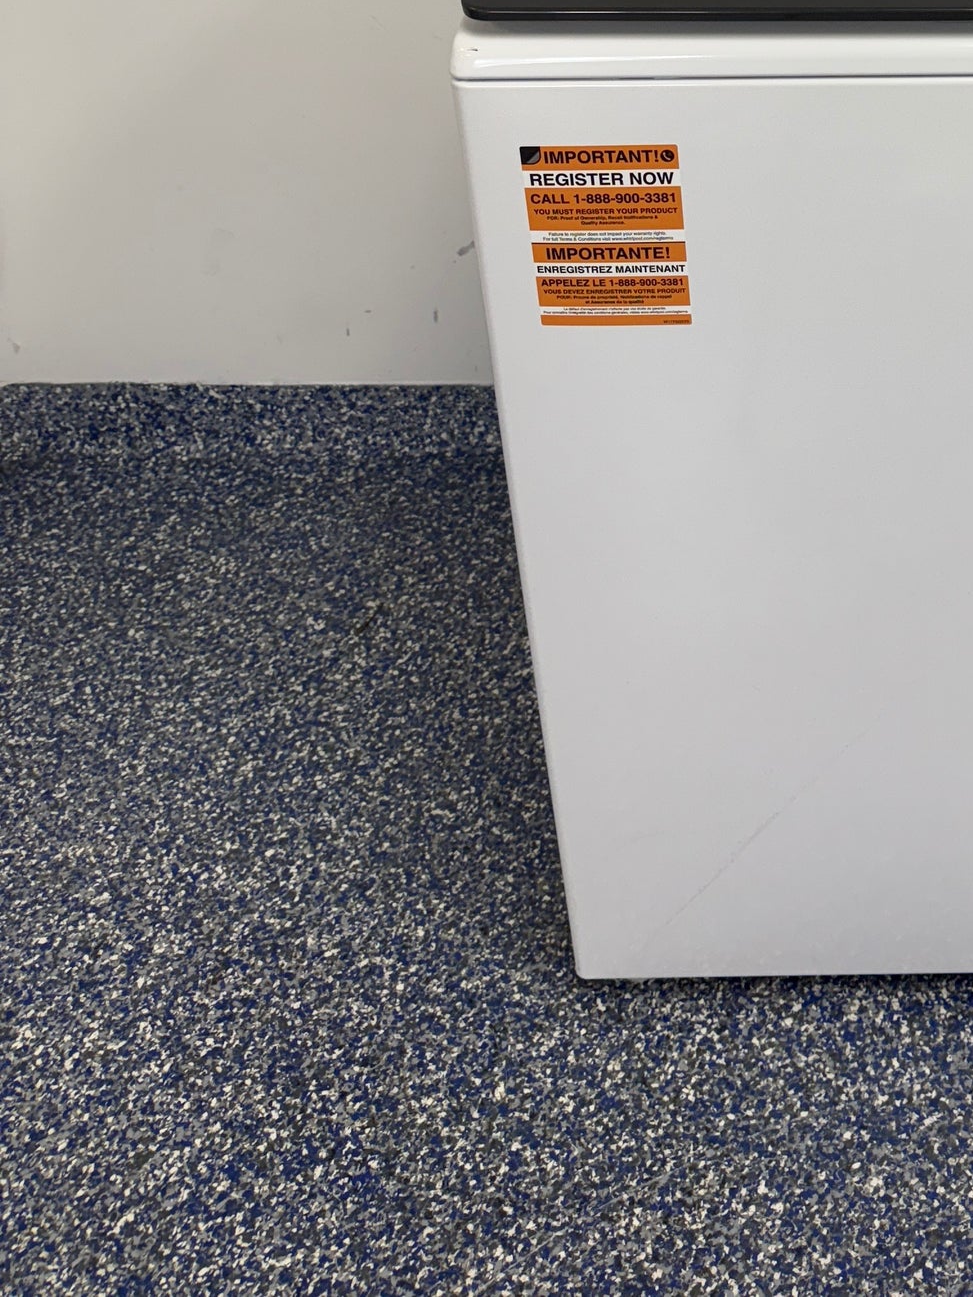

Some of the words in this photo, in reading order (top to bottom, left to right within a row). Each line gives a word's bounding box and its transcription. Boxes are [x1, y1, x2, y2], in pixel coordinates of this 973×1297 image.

[544, 150, 659, 164] IMPORTANT!
[530, 173, 624, 186] REGISTER
[630, 172, 674, 185] NOW
[530, 194, 570, 204] CALL
[573, 193, 676, 204] 1-888-900-3381
[546, 247, 670, 260] IMPORTANTE!
[616, 265, 685, 273] MAINTENANT
